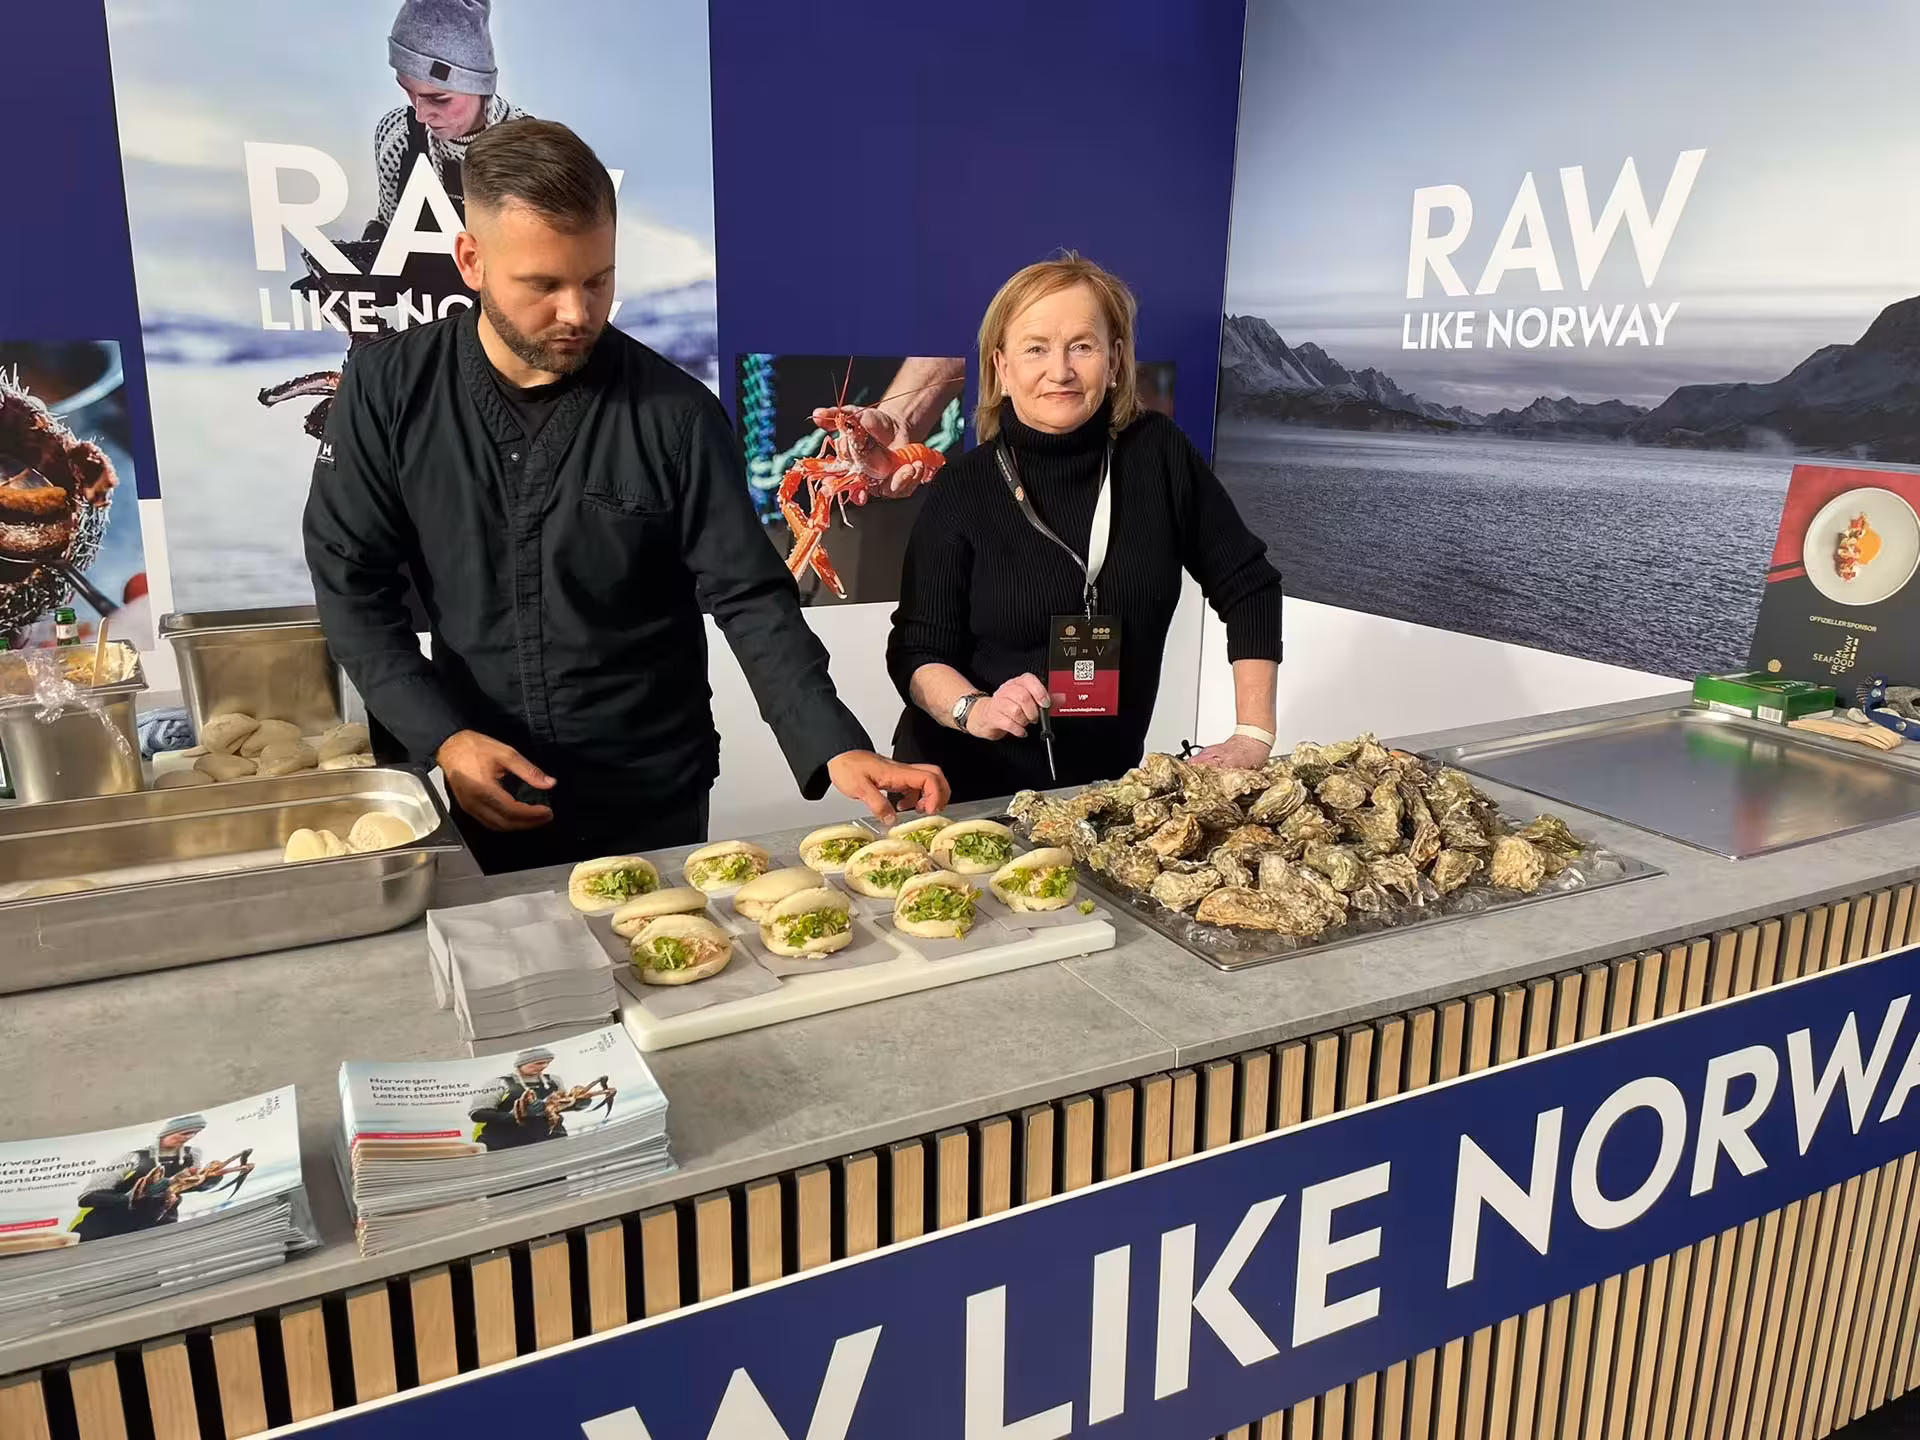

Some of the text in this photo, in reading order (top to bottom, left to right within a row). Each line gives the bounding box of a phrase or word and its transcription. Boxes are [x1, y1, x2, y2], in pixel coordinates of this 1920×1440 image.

[244, 141, 625, 276] RA
[1406, 148, 1707, 299] RAW
[257, 287, 380, 334] LIKE
[1401, 302, 1681, 350] LIKE NORWAY
[1847, 622, 1877, 632] SPONSOR
[1812, 653, 1855, 667] SEAFOOD
[1830, 650, 1842, 675] FROM
[1839, 635, 1853, 673] NORWAY
[369, 1077, 437, 1085] Norwegen
[413, 1082, 470, 1093] perfekte
[0, 1155, 61, 1166] rwegen
[29, 1160, 97, 1174] perfekte
[964, 1161, 1391, 1440] LIKE
